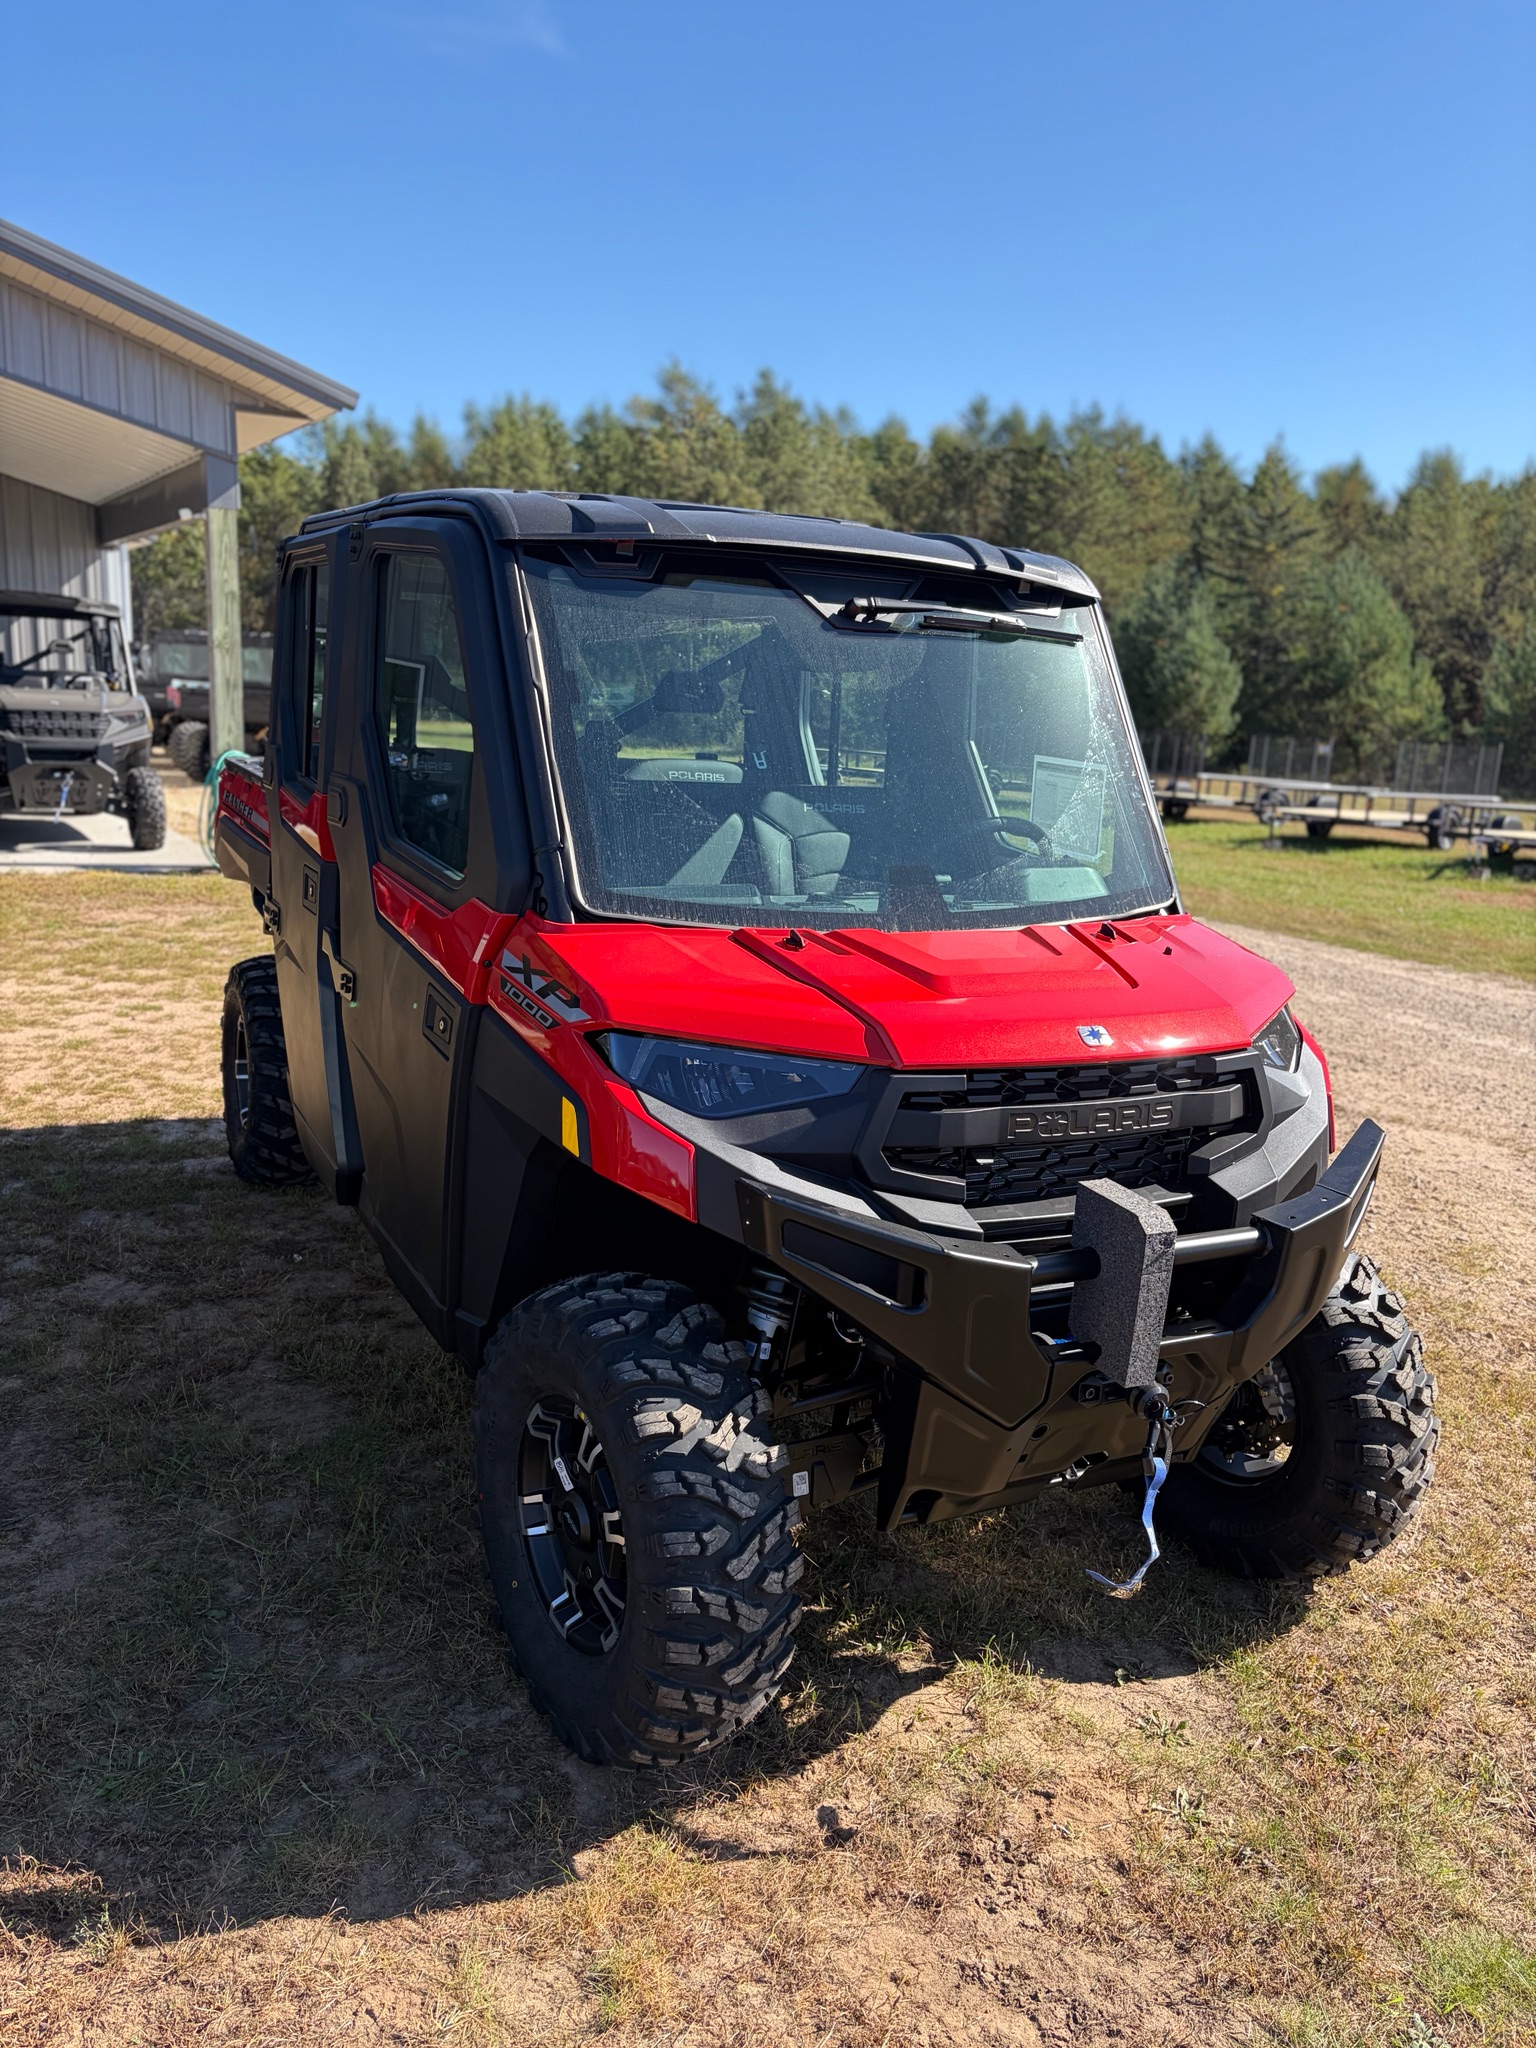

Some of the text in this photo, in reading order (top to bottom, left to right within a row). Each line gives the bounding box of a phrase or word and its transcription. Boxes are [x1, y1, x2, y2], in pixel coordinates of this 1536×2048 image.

[668, 771, 725, 782] POLARIS
[223, 790, 254, 820] RANGER
[803, 803, 866, 814] POLARIS
[504, 953, 581, 1008] XP
[503, 982, 554, 1027] 1000
[1007, 1101, 1174, 1139] POLARIS
